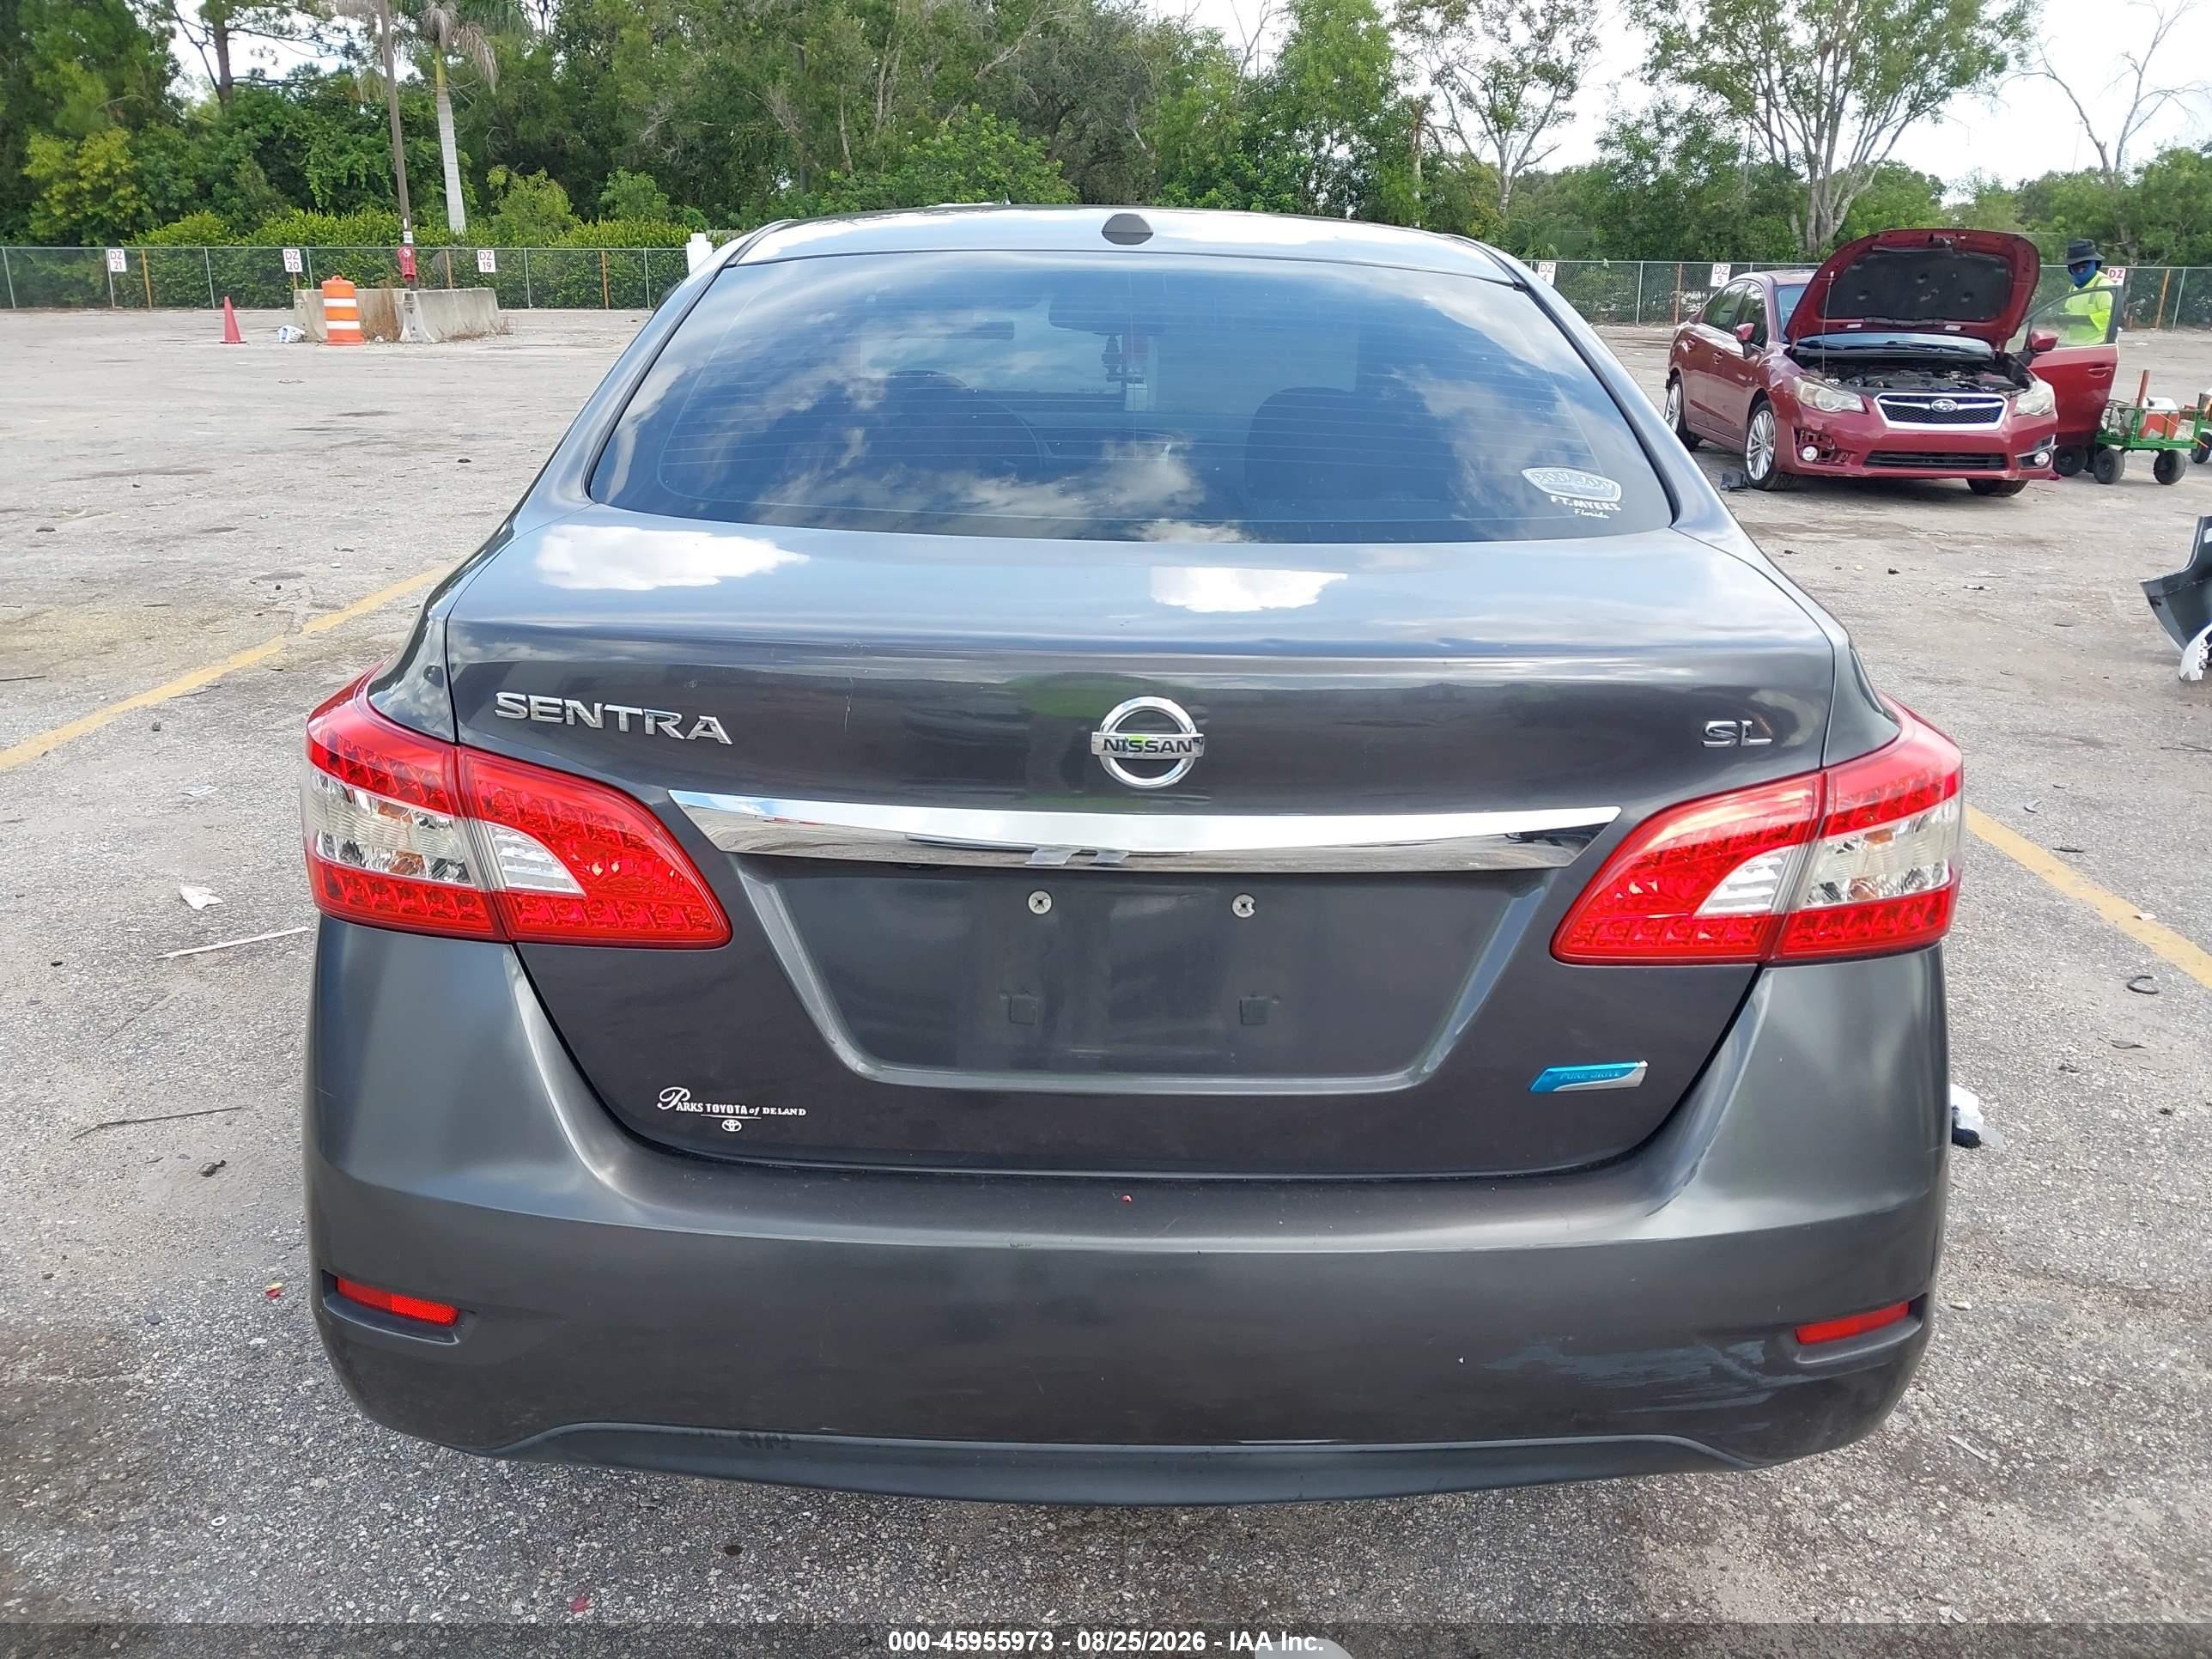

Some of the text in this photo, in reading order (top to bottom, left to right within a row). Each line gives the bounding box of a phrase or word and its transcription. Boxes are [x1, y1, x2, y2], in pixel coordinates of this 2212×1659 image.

[110, 251, 123, 260] DZ
[285, 251, 299, 260] DZ
[479, 252, 493, 260] DZ
[113, 261, 123, 270] 21
[287, 261, 300, 270] 20
[483, 262, 492, 270] 19
[1540, 264, 1554, 273] DZ
[1714, 265, 1729, 275] DZ
[2109, 270, 2124, 279] DZ
[1717, 275, 1723, 284] 5
[495, 690, 734, 744] SENTRA
[1701, 720, 1773, 749] SL
[1103, 738, 1194, 754] NISSAN
[1559, 1072, 1588, 1080] PURE
[705, 1103, 748, 1115] TOYOTA
[749, 1106, 761, 1116] of
